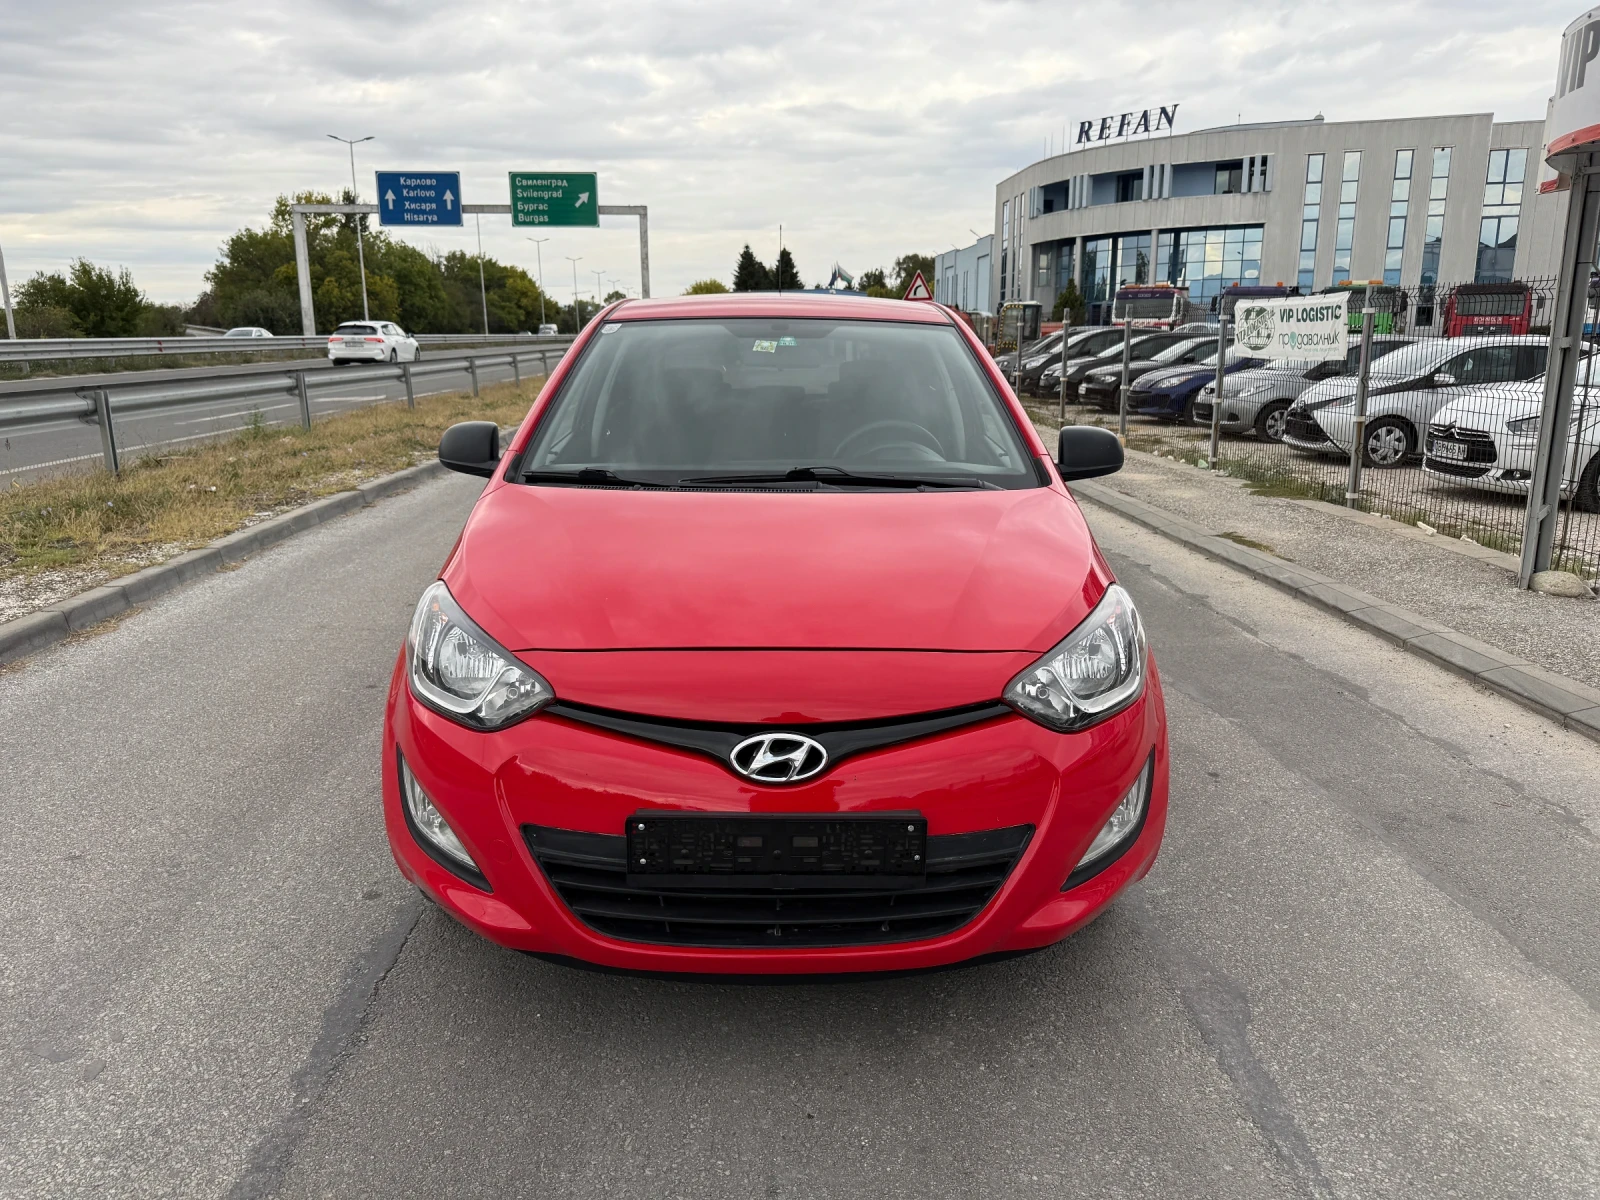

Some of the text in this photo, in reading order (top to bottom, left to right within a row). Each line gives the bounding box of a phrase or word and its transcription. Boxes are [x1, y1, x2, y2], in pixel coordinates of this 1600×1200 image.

[1076, 104, 1180, 144] REFAN
[400, 177, 436, 187] Карлово
[516, 178, 568, 188] Свиленград
[403, 189, 435, 197] Karlovo
[517, 189, 562, 199] Svilengrad
[404, 201, 436, 211] Хисаря
[517, 202, 548, 212] Бургас
[404, 213, 438, 223] Hisarya
[518, 213, 549, 223] Burgas
[1280, 305, 1341, 323] VIP LOGISTIC
